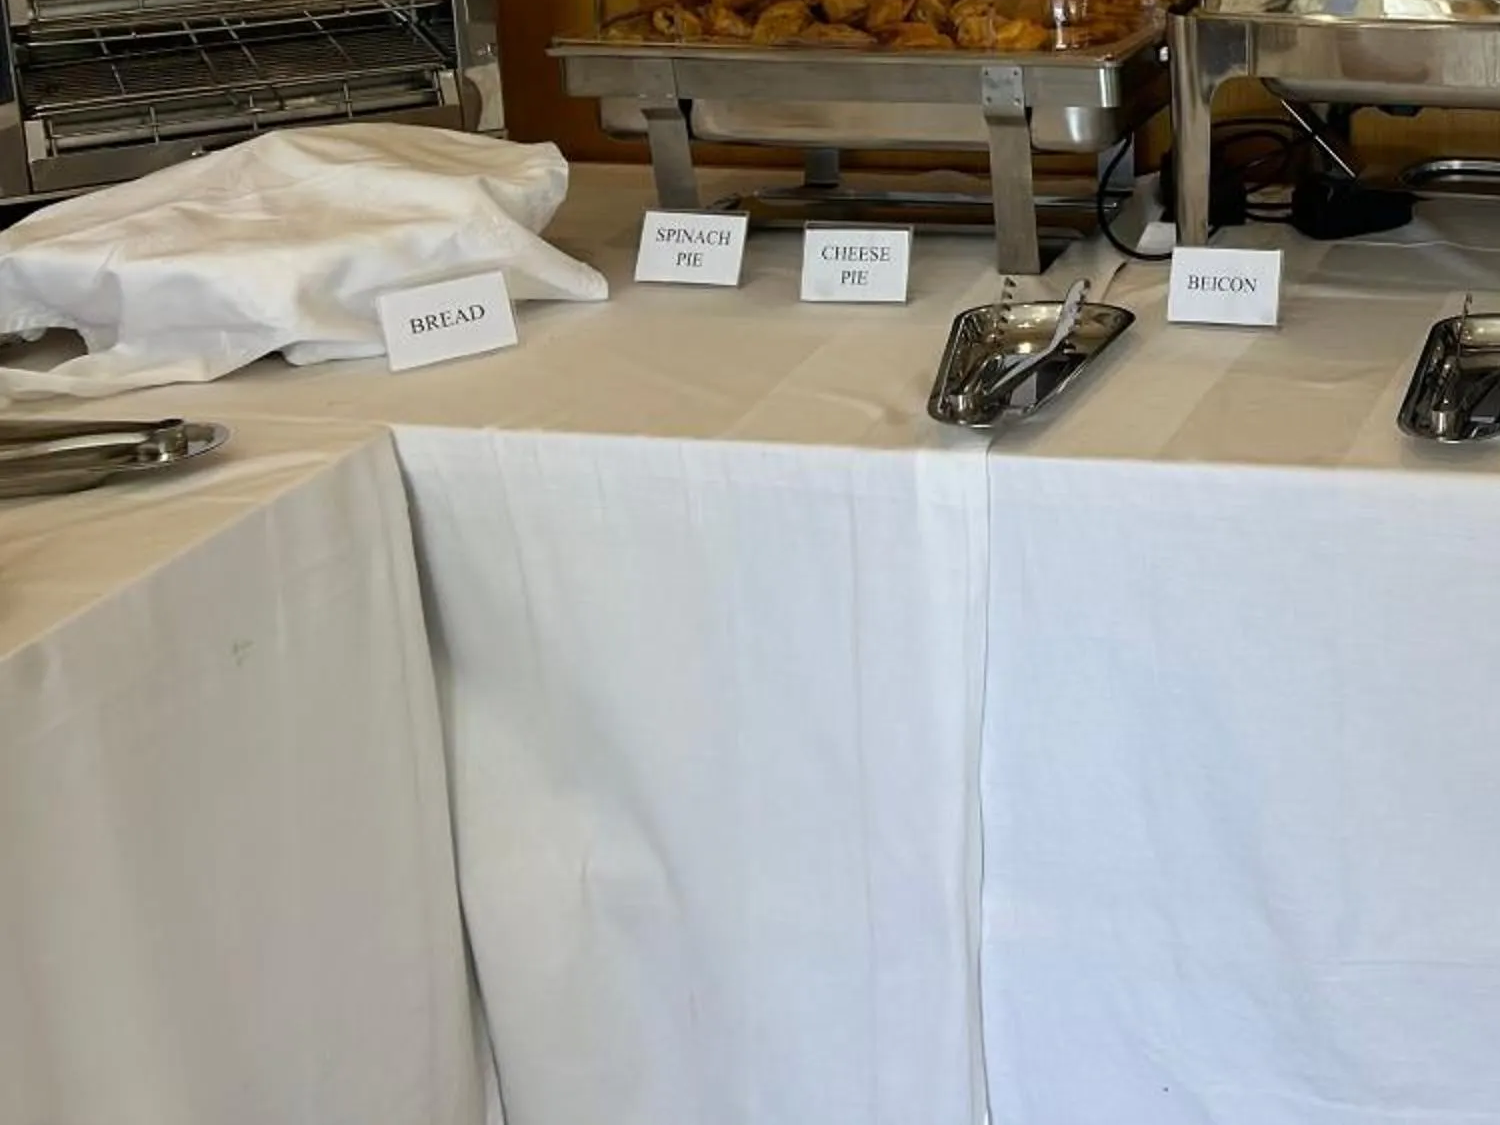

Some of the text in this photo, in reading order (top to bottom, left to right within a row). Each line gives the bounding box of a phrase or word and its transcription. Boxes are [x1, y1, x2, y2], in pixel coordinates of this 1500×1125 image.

[656, 227, 732, 246] SPINACH
[676, 252, 704, 268] PIE
[821, 246, 891, 262] CHEESE
[841, 270, 869, 286] PIE
[1187, 274, 1257, 293] BEICON
[410, 304, 486, 334] BREAD
